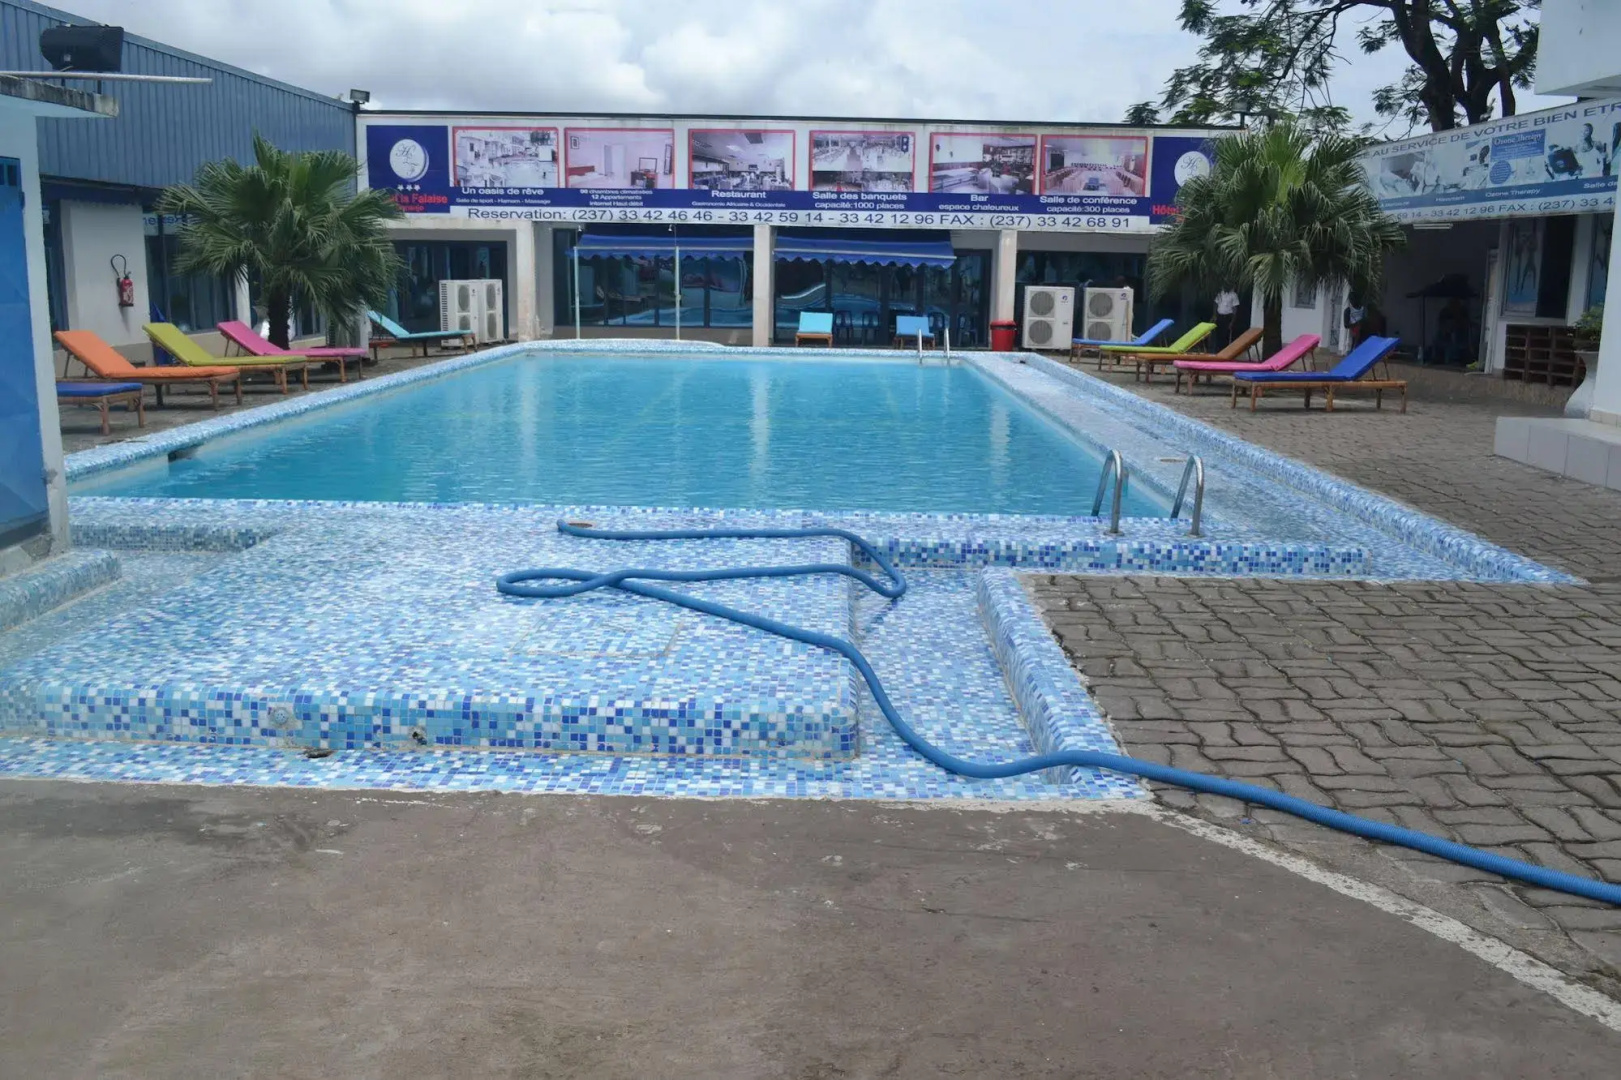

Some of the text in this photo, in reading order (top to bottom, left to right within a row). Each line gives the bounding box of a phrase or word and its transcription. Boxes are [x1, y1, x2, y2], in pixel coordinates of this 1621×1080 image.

[1373, 148, 1388, 156] AU
[1391, 137, 1447, 152] SERVICE
[1451, 132, 1469, 142] DE
[1474, 121, 1527, 137] VOTRE
[1534, 110, 1577, 126] BIEN
[412, 193, 448, 203] Falaise
[711, 190, 766, 198] Restaurant
[861, 193, 907, 201] banquets
[1538, 200, 1575, 211] (237)
[1580, 198, 1598, 207] 33
[1604, 197, 1615, 205] 4
[468, 208, 567, 219] Reservation:
[572, 209, 613, 221] (237)
[618, 210, 637, 220] 33
[643, 210, 662, 220] 42
[668, 211, 687, 221] 46
[693, 211, 712, 221] 46
[729, 211, 748, 221] 33
[754, 212, 773, 222] 42
[779, 212, 798, 222] 59
[805, 213, 823, 222] 14
[840, 213, 859, 223] 33
[864, 214, 884, 223] 42
[891, 214, 908, 224] 12
[914, 214, 934, 224] 96
[940, 215, 974, 225] FAX
[990, 216, 1030, 228] (237)
[1037, 217, 1056, 227] 33
[1061, 217, 1081, 227] 42
[1086, 218, 1106, 227] 68
[1112, 218, 1129, 227] 91
